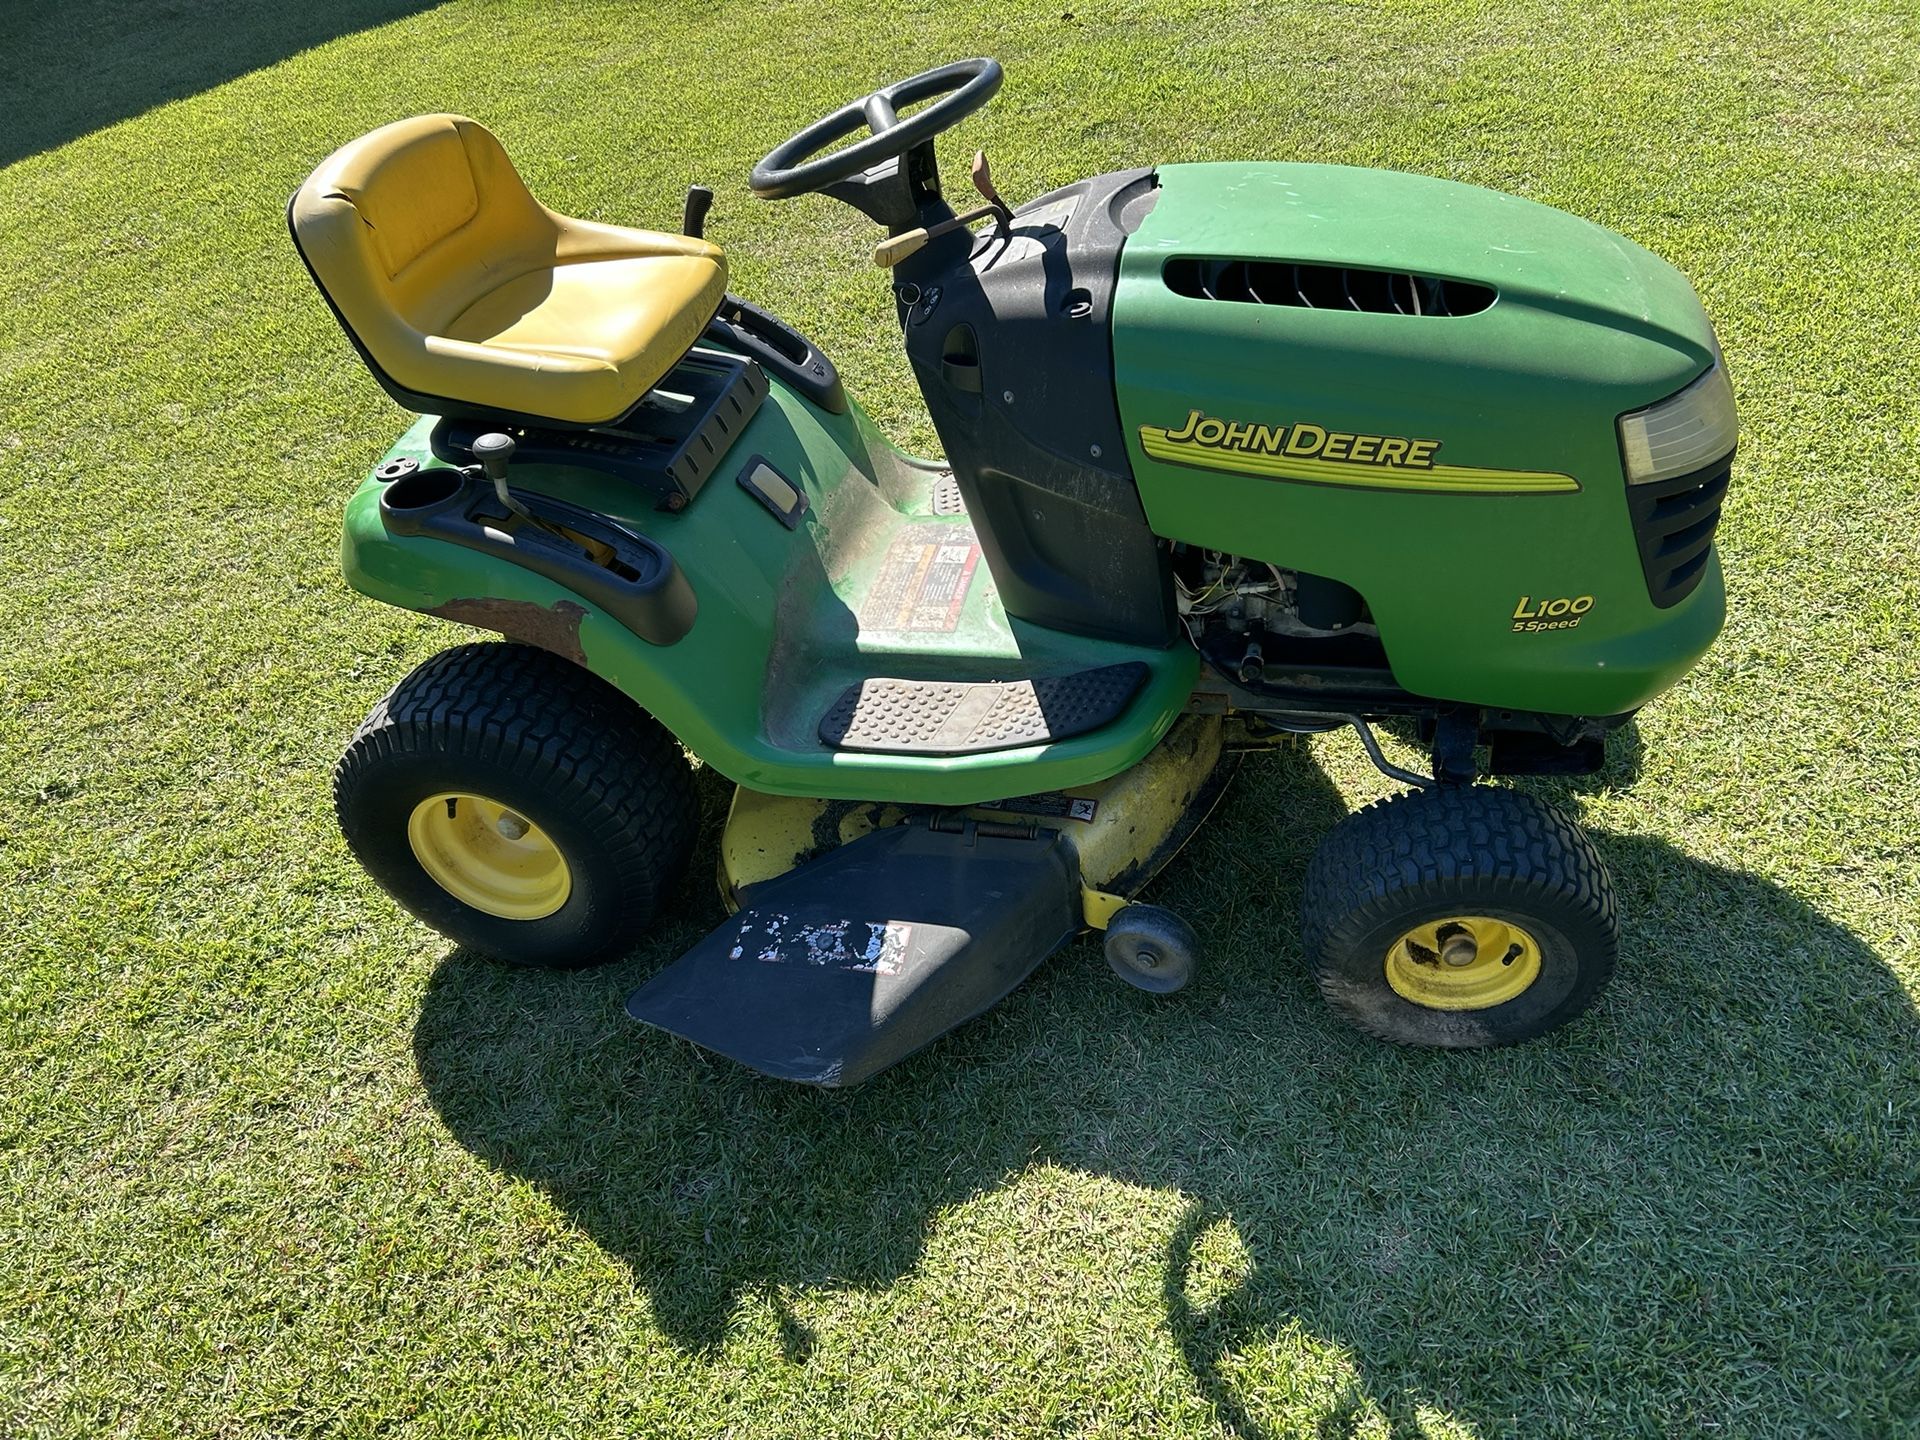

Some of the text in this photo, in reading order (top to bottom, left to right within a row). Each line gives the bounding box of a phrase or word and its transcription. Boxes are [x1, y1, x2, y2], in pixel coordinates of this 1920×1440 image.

[1166, 411, 1439, 467] JOHN DEERE
[1513, 596, 1594, 618] L100
